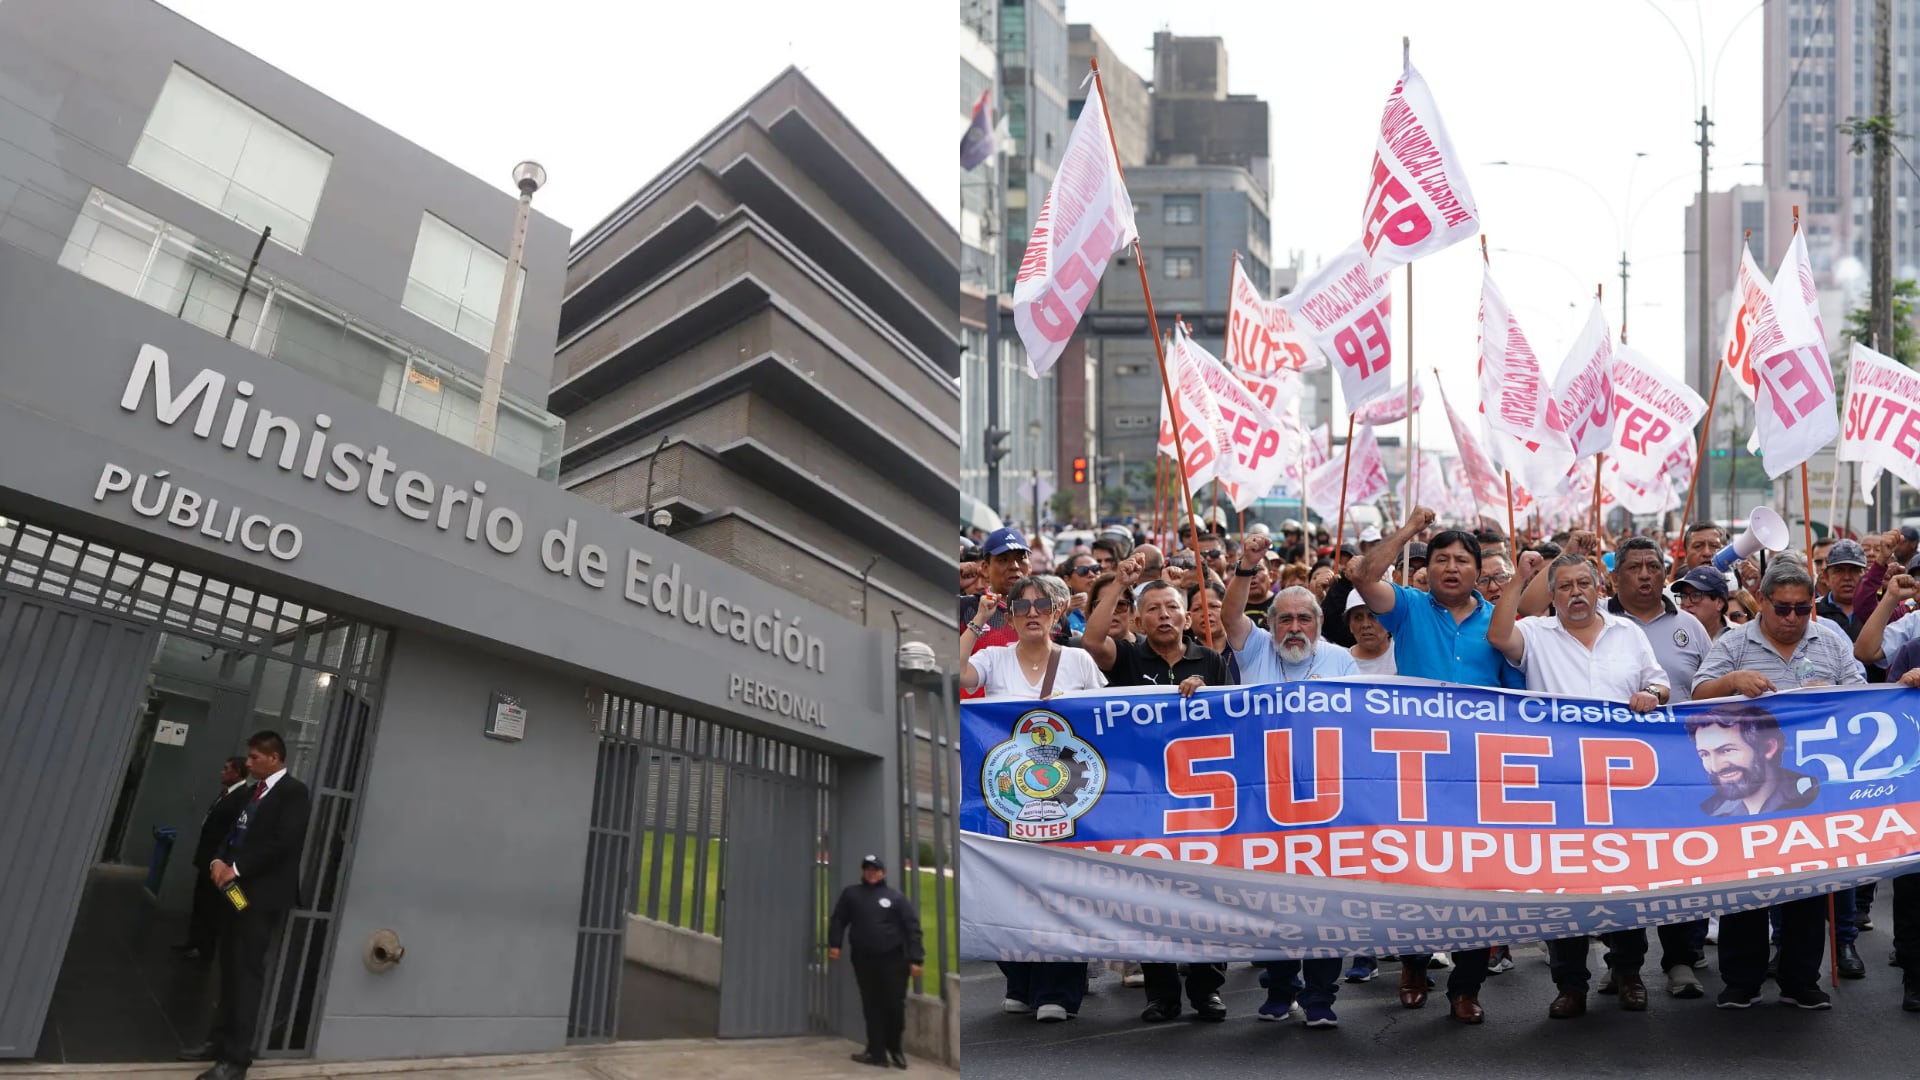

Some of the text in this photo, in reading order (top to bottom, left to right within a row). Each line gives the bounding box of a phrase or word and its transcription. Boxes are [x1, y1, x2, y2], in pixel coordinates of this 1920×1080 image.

[1362, 149, 1432, 258] TEP
[1390, 125, 1443, 178] SINDICAL
[1417, 170, 1473, 228] CLASISTA!
[1845, 392, 1920, 466] SUTE
[93, 462, 303, 560] PÚBLICO
[120, 343, 826, 674] Ministerio de Educación
[728, 673, 828, 728] PERSONAL
[1094, 700, 1168, 735] ¡Por
[1180, 696, 1210, 722] la
[1224, 686, 1352, 718] Unidad
[1365, 688, 1505, 722] Sindical
[1162, 727, 1660, 835] SUTEP
[1796, 711, 1904, 795] 52
[1848, 783, 1897, 801] años
[1015, 822, 1069, 838] SUTEP
[1243, 828, 1719, 877] PRESUPUESTO
[1741, 808, 1918, 859] PARA
